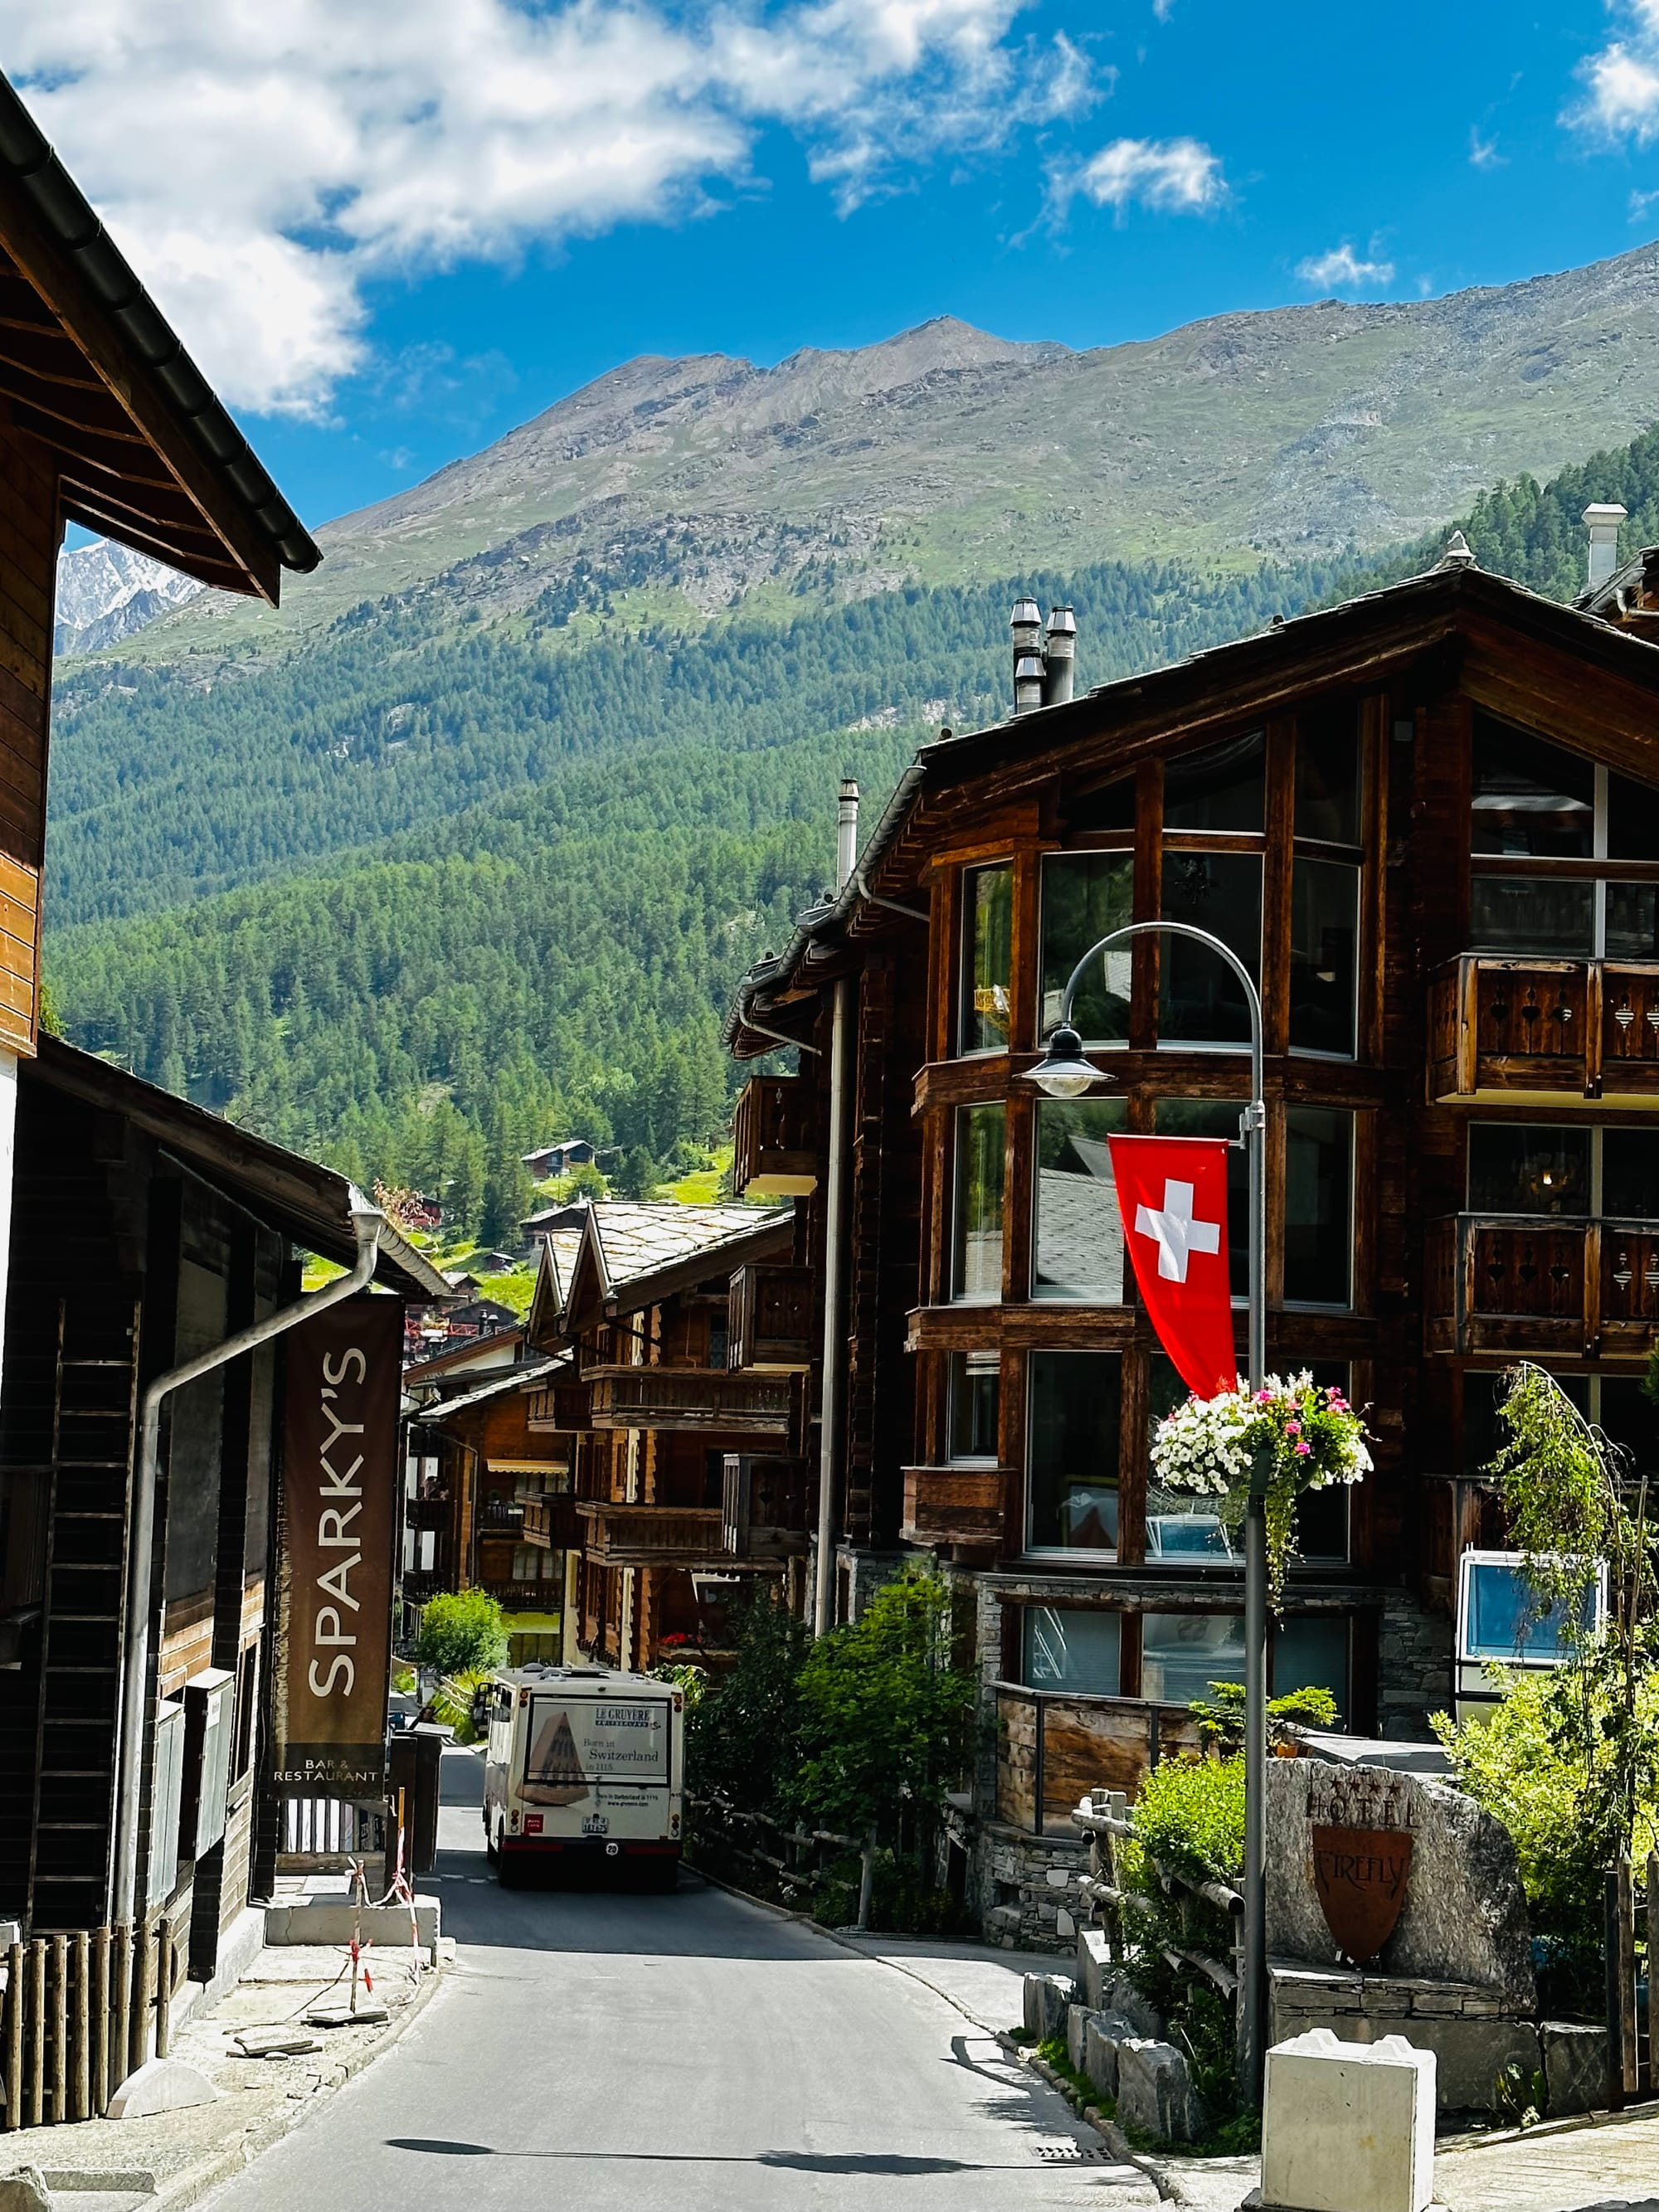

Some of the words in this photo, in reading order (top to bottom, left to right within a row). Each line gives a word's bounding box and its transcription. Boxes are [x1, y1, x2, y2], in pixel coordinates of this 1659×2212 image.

[309, 1347, 367, 1698] SPARKY'S
[596, 1708, 607, 1719] LE
[589, 1749, 659, 1762] Switzerland
[305, 1759, 335, 1770] BAR
[340, 1760, 348, 1769] &
[274, 1771, 379, 1782] RESTAURANT
[1306, 1791, 1419, 1828] HOTEL
[607, 1845, 616, 1854] 20
[1316, 1850, 1407, 1898] FIREFLY
